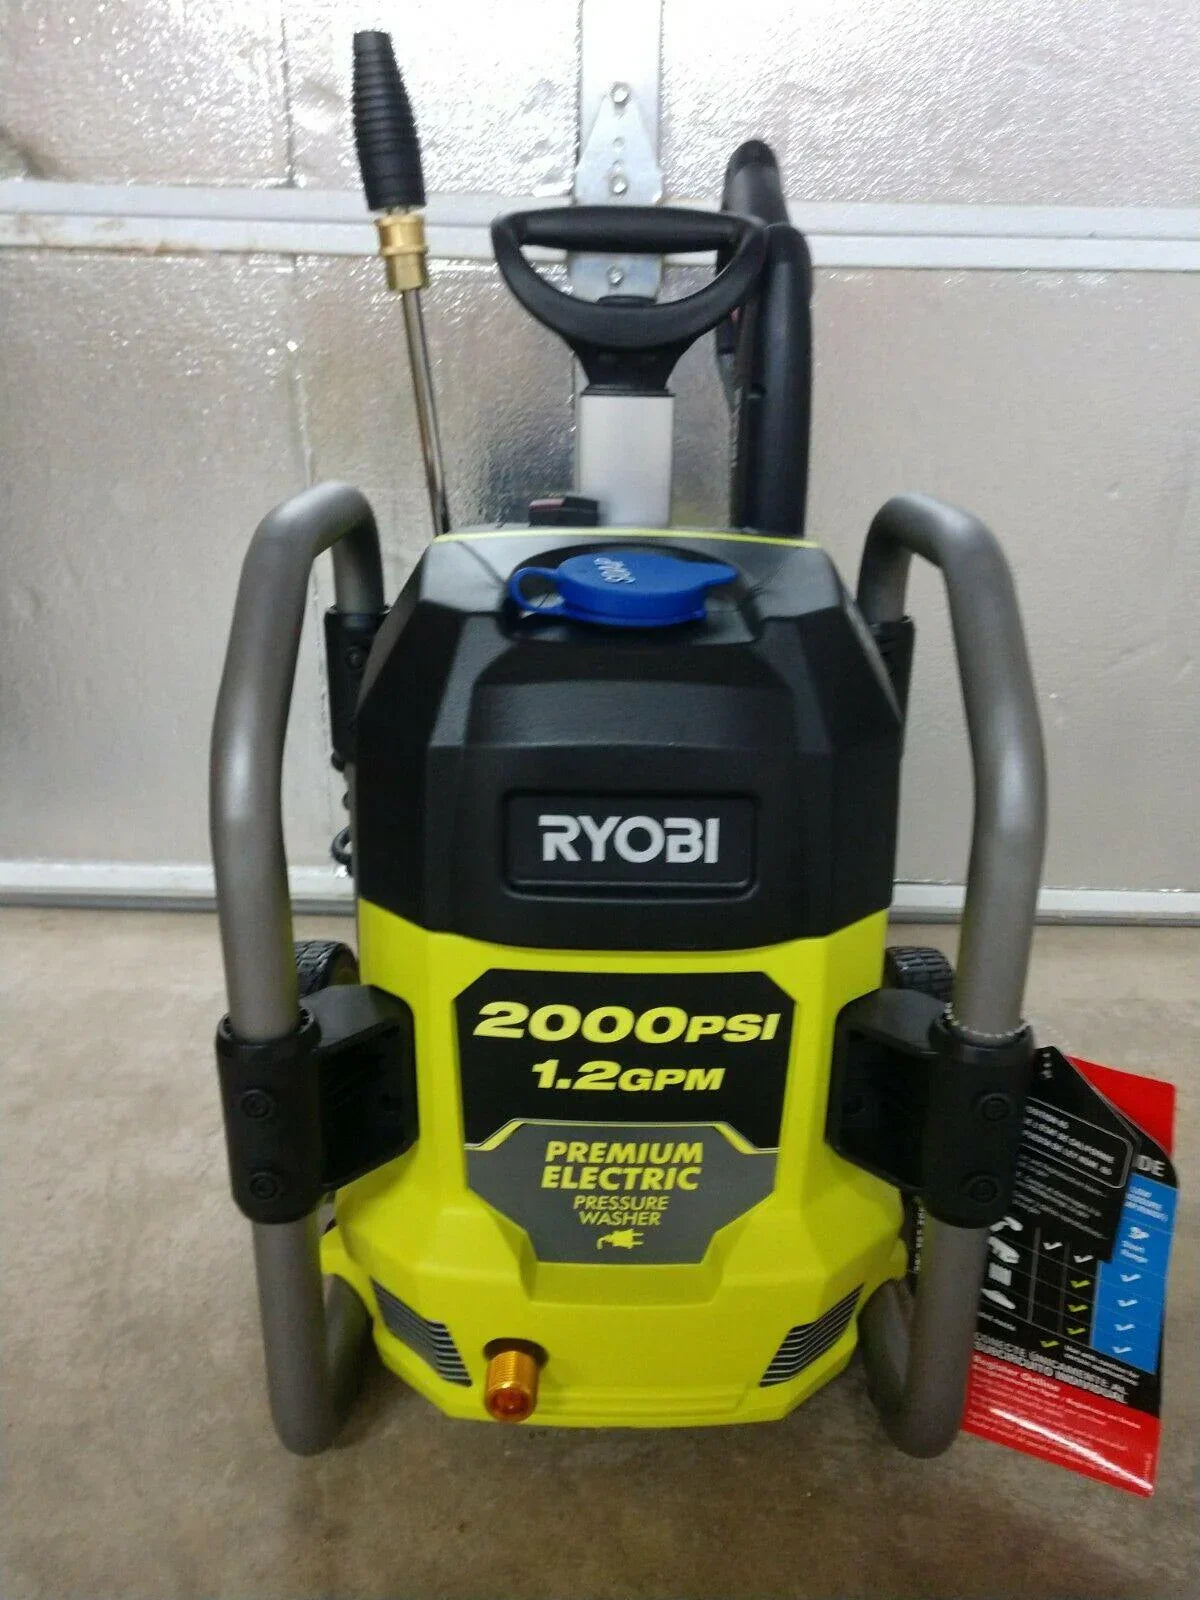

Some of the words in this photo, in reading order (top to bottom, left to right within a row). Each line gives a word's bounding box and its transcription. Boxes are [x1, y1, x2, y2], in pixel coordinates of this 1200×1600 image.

[538, 814, 720, 864] RYOBI
[545, 1141, 703, 1164] PREMIUM
[541, 1165, 701, 1190] ELECTRIC
[573, 1194, 668, 1211] PRESSURE
[579, 1210, 662, 1226] WASHER
